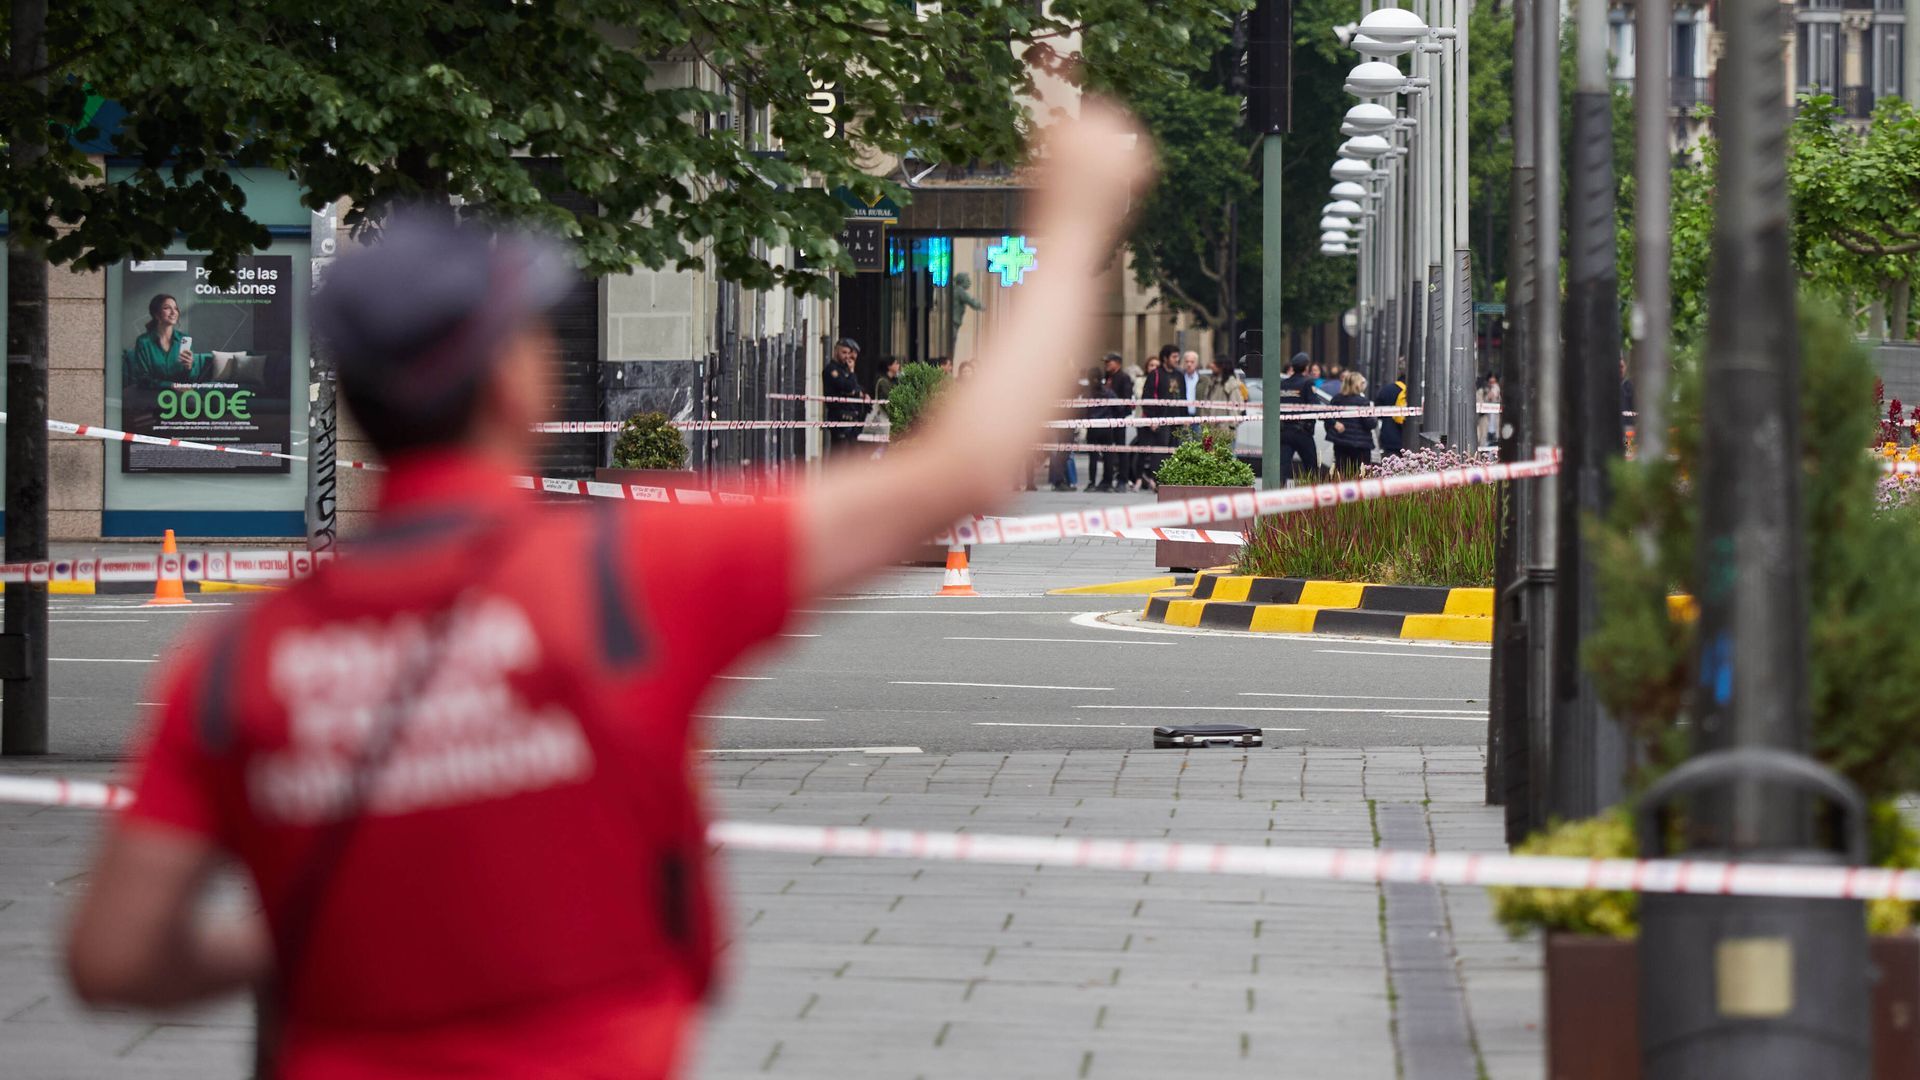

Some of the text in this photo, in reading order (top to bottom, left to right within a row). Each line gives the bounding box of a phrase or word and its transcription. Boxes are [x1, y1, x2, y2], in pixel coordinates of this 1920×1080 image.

[238, 267, 256, 280] de
[257, 267, 279, 280] las
[195, 282, 277, 295] comsiones
